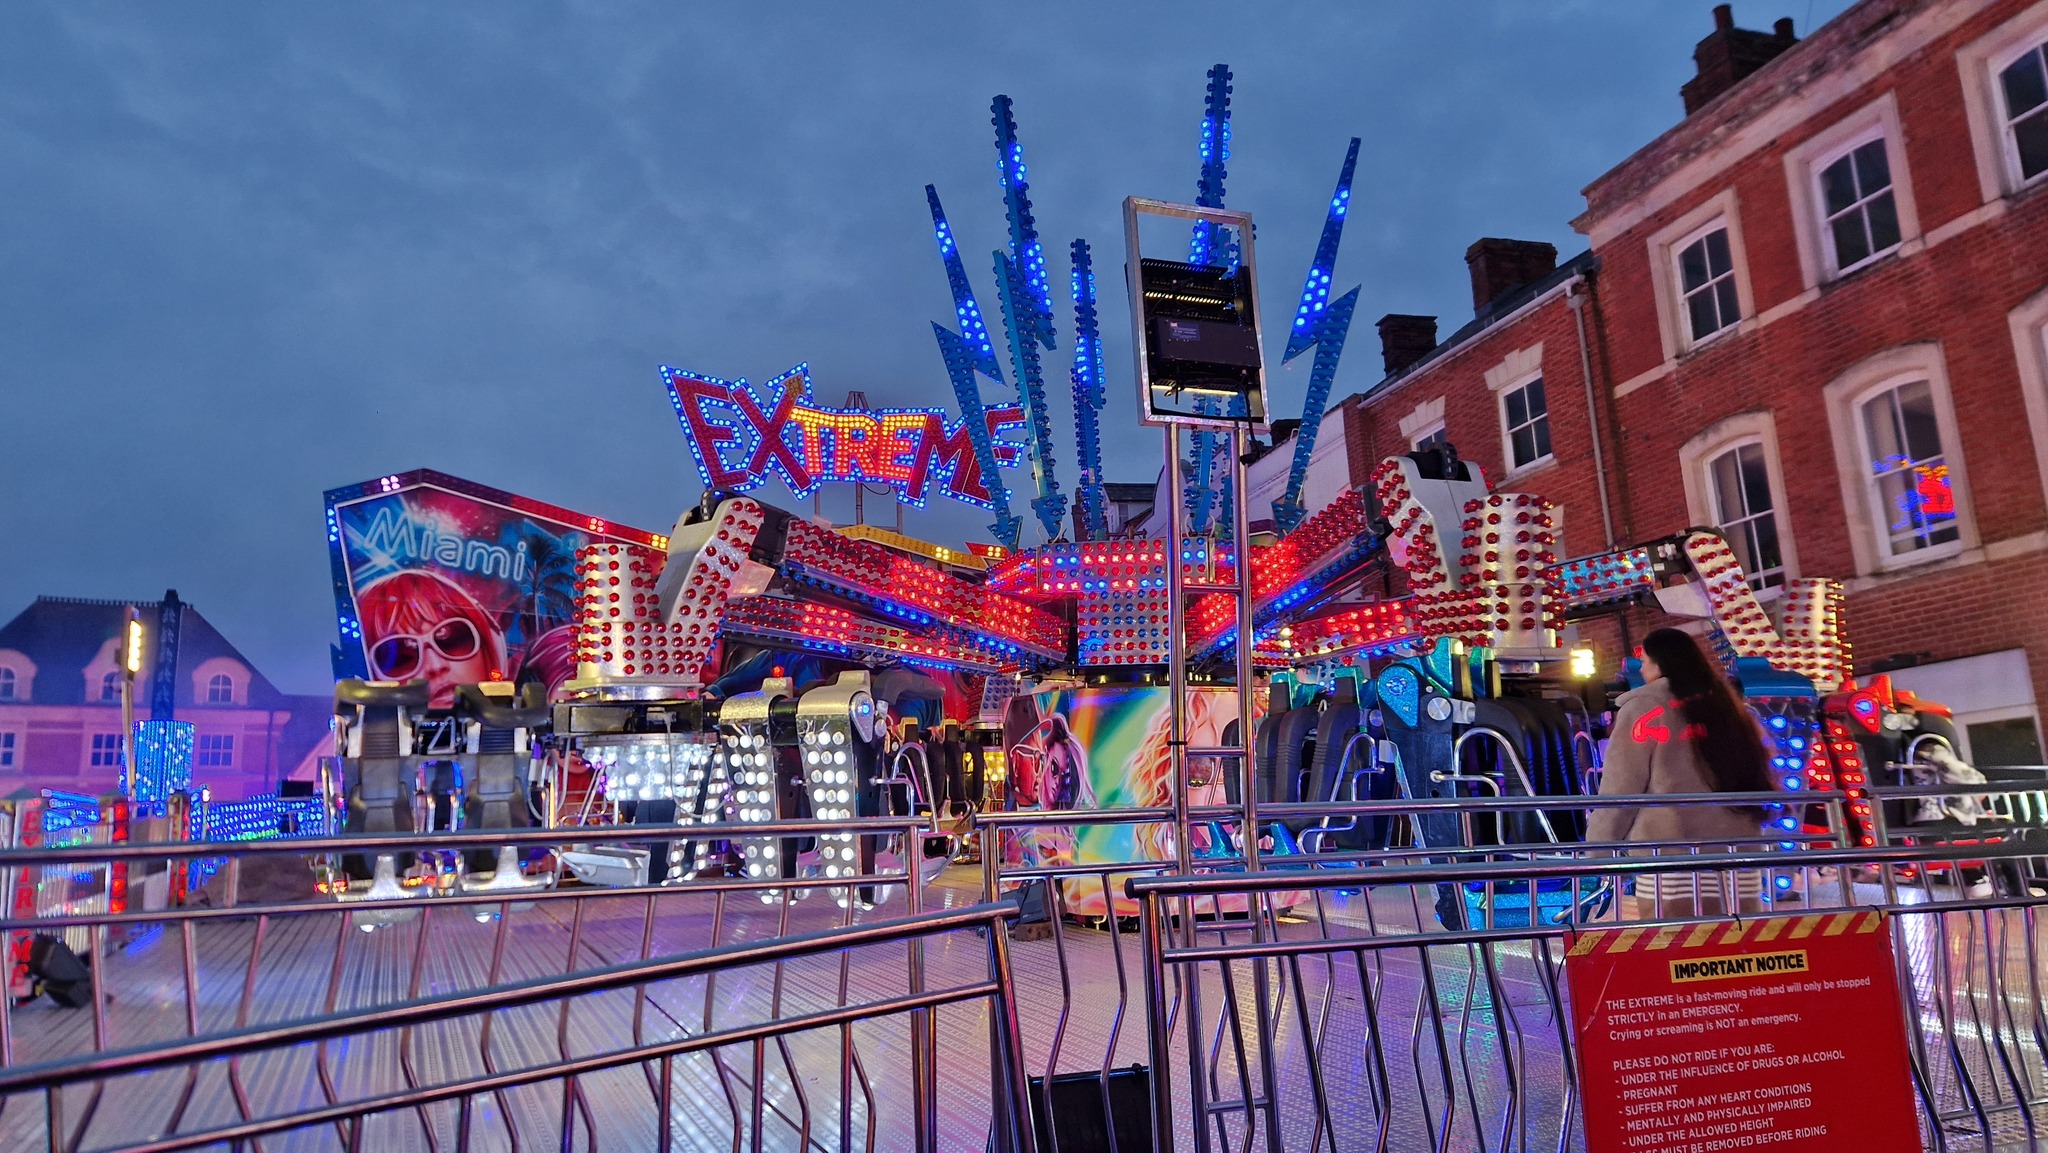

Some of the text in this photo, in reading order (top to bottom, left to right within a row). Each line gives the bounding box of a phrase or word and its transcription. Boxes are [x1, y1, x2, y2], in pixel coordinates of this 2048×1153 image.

[660, 362, 1026, 511] EXTREME
[363, 506, 526, 581] Miami
[1674, 954, 1804, 979] IMPORTANT NOTICE
[1606, 1000, 1626, 1010] THE
[1628, 995, 1674, 1008] EXTREME
[1676, 994, 1684, 1004] is
[1694, 989, 1747, 1002] fast-moving
[1749, 987, 1767, 996] ride
[1768, 984, 1785, 994] and
[1786, 982, 1802, 992] will
[1804, 981, 1822, 992] only
[1824, 980, 1834, 989] be
[1837, 976, 1870, 988] stopped
[1608, 1004, 1743, 1026] STRICTLY in an EMERGENCY.
[1610, 1013, 1801, 1042] Crying or screaming is NOT an emergency.
[1614, 1044, 1775, 1071] PLEASE DO NOT RIDE IF YOU ARE:
[1622, 1072, 1657, 1085] UNDER
[1659, 1069, 1678, 1080] THE
[1681, 1062, 1734, 1078] INFLUENCE
[1737, 1062, 1750, 1071] OF
[1752, 1057, 1784, 1070] DRUGS
[1786, 1055, 1800, 1065] OR
[1802, 1050, 1845, 1064] ALCOHOL
[1624, 1084, 1678, 1100] PREGNANT
[1625, 1102, 1664, 1116] SUFFER
[1666, 1098, 1694, 1110] FROM
[1698, 1095, 1718, 1106] ANY
[1720, 1090, 1752, 1103] HEART
[1754, 1082, 1812, 1098] CONDITIONS
[1627, 1115, 1680, 1131] MENTALLY
[1684, 1112, 1704, 1124] AND
[1707, 1104, 1764, 1120] PHYSICALLY
[1768, 1098, 1812, 1112] IMPAIRED
[1629, 1132, 1664, 1146] UNDER
[1666, 1130, 1686, 1141] THE
[1688, 1122, 1737, 1138] ALLOWED
[1740, 1118, 1774, 1132] HEIGHT
[1690, 1142, 1704, 1153] BE
[1706, 1136, 1754, 1152] REMOVED
[1756, 1130, 1794, 1144] BEFORE
[1796, 1125, 1826, 1138] RIDING
